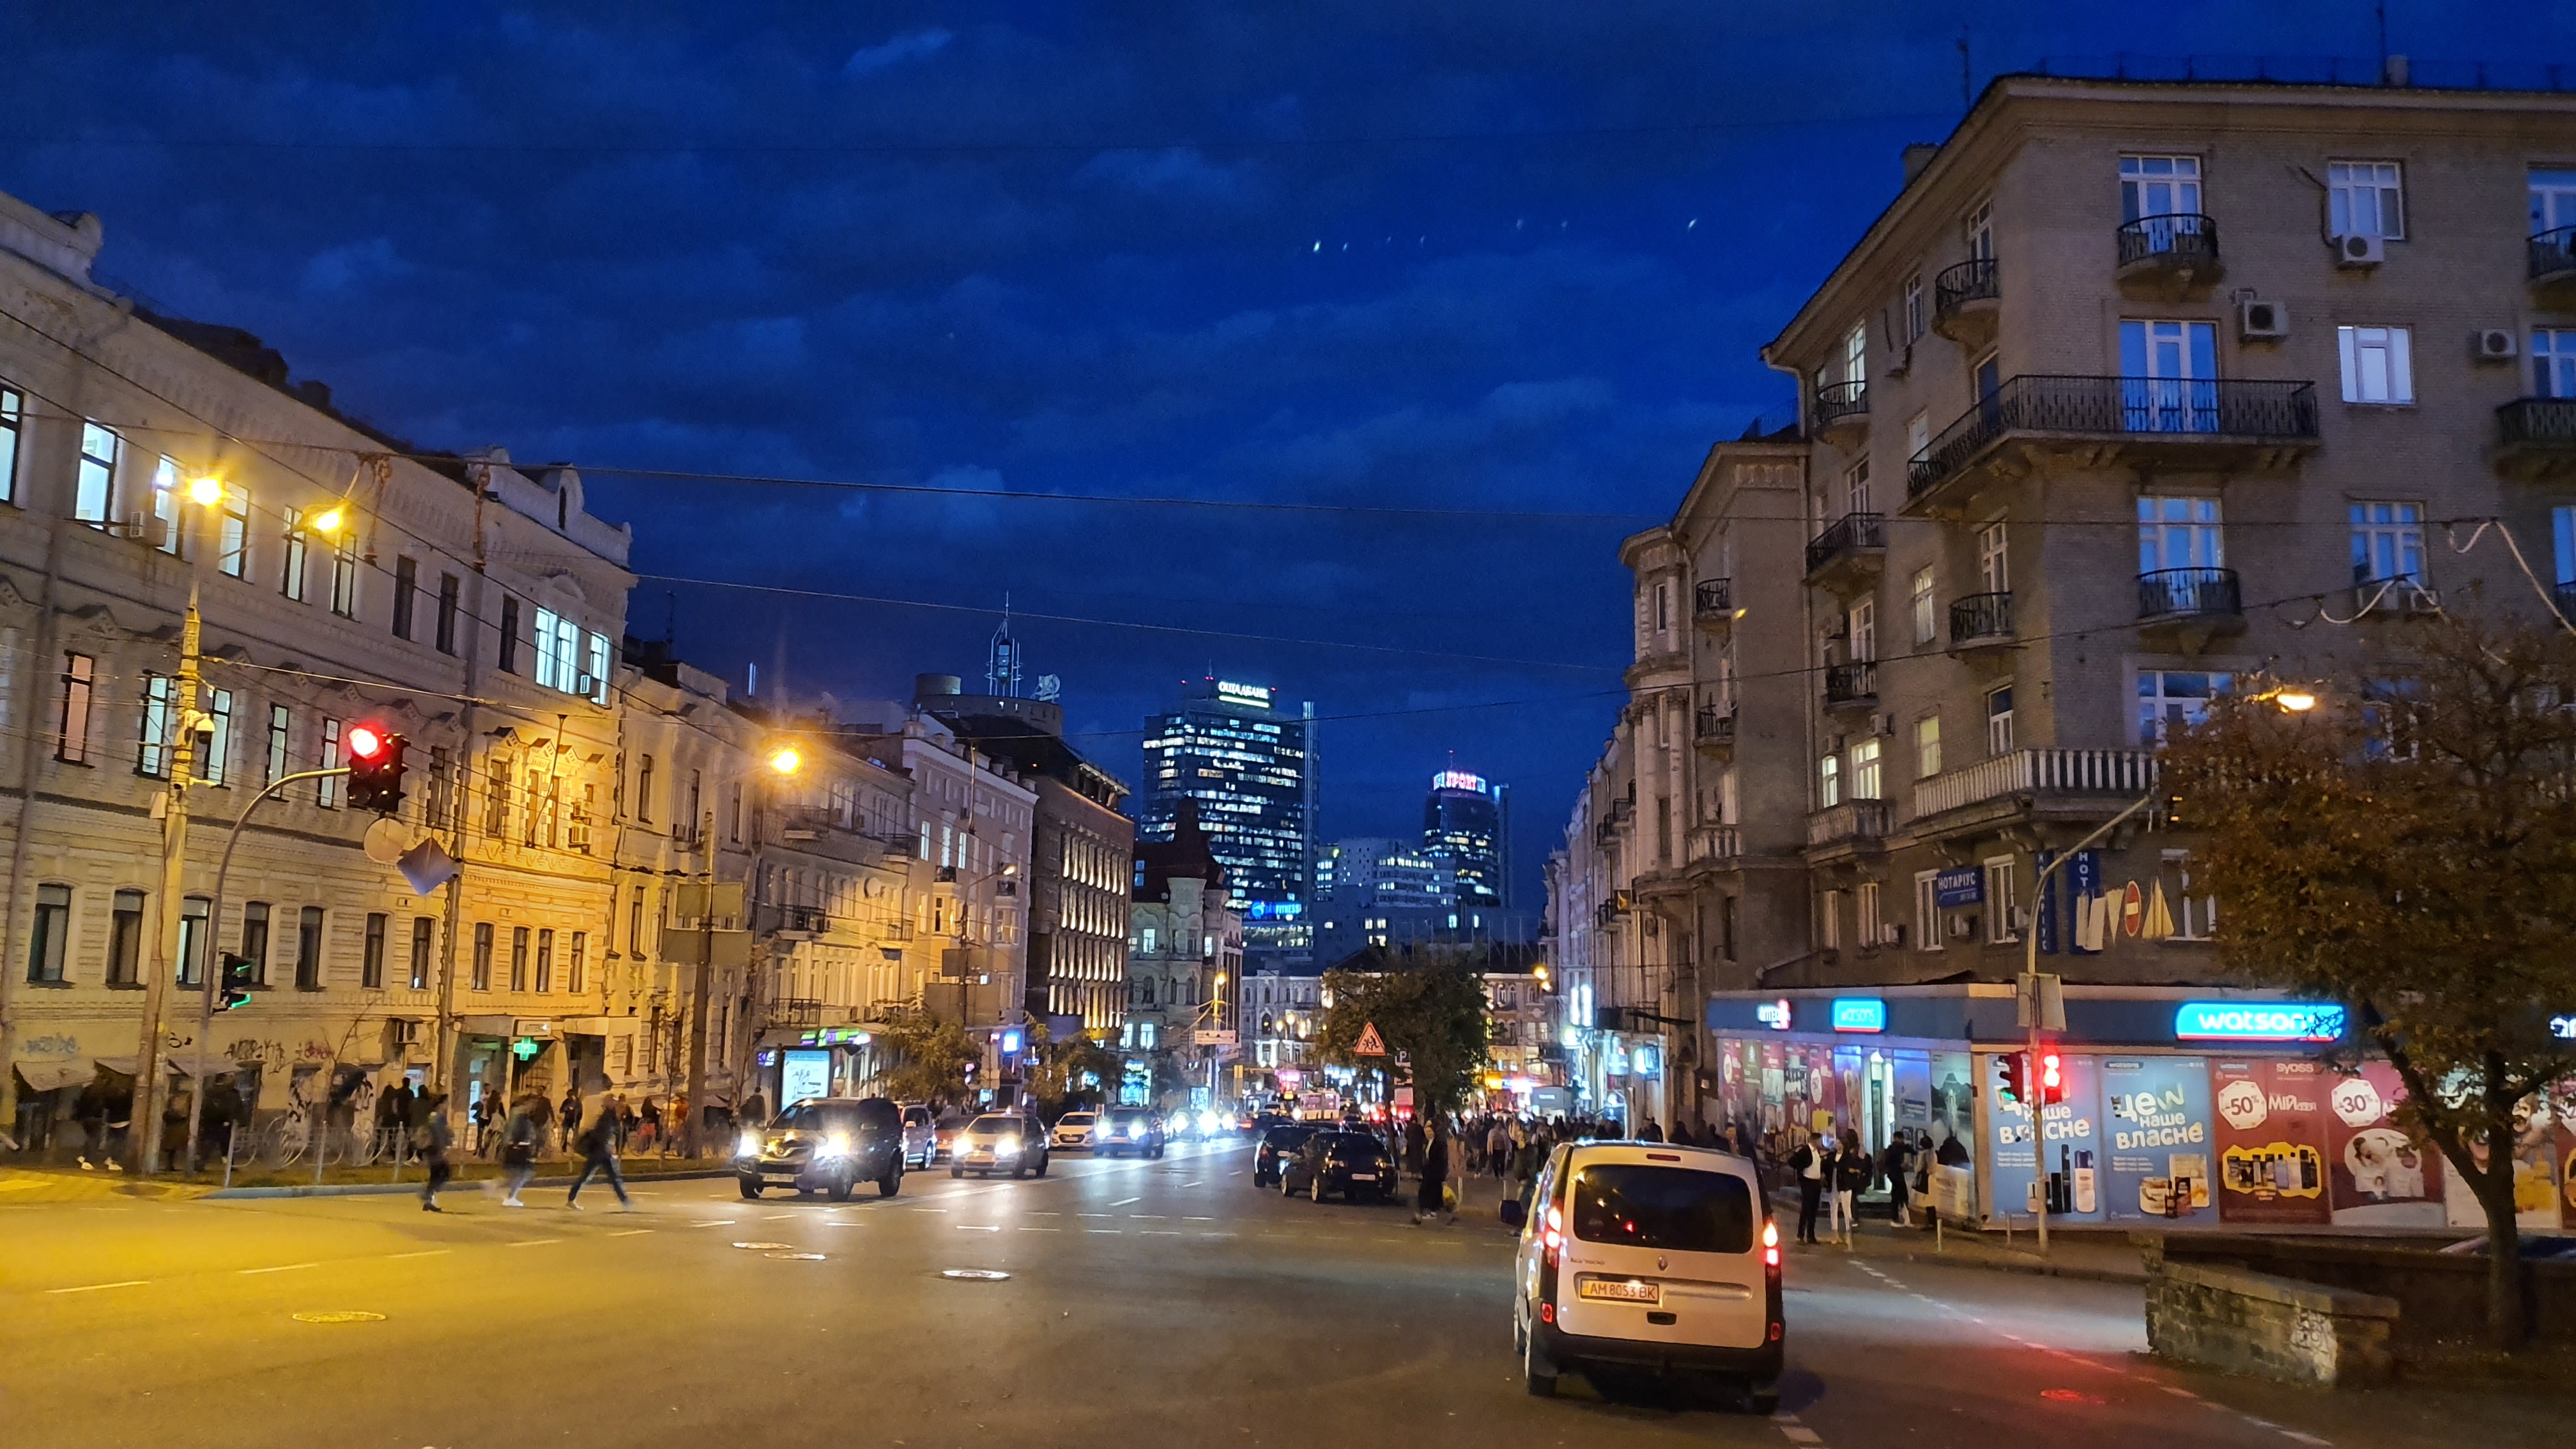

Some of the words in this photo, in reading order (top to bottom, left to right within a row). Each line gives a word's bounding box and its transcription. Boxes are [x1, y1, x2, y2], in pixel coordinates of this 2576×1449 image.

[1218, 681, 1269, 700] ОЩАДБАНК
[1938, 872, 1975, 891] НОТАРІУС
[2198, 1011, 2317, 1031] watson
[2276, 1062, 2314, 1075] syoss
[2140, 1112, 2186, 1128] наше
[2115, 1122, 2204, 1150] власне
[1590, 1283, 1607, 1295] AM
[1609, 1284, 1636, 1298] 8053
[1639, 1286, 1656, 1300] BK
